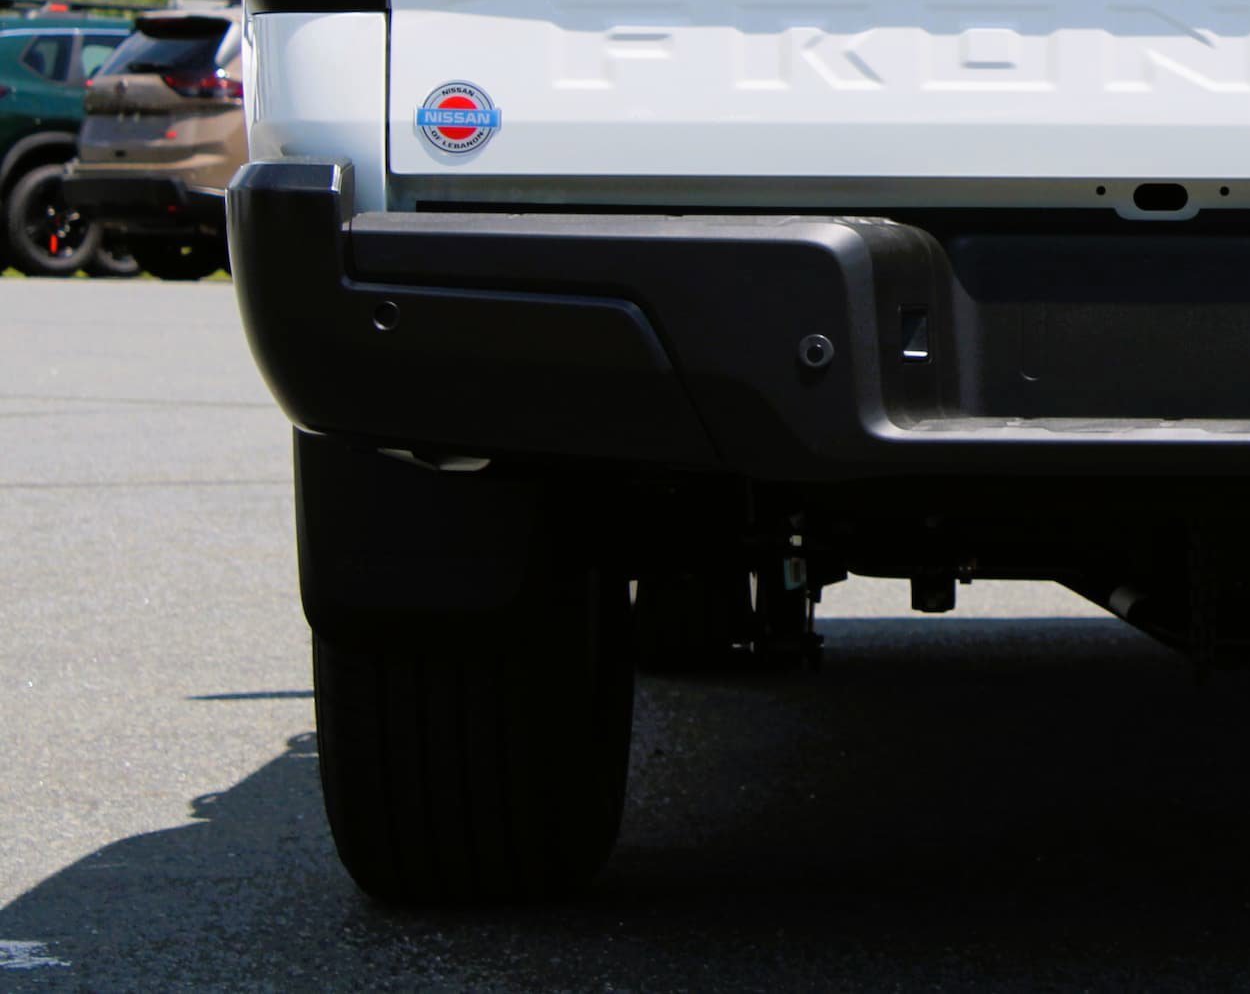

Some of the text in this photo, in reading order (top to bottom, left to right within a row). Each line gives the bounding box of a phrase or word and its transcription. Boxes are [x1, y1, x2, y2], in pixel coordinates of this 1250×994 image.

[441, 87, 475, 97] NISSAN
[424, 111, 490, 125] NISSAN
[431, 128, 484, 150] OF LEBANON
